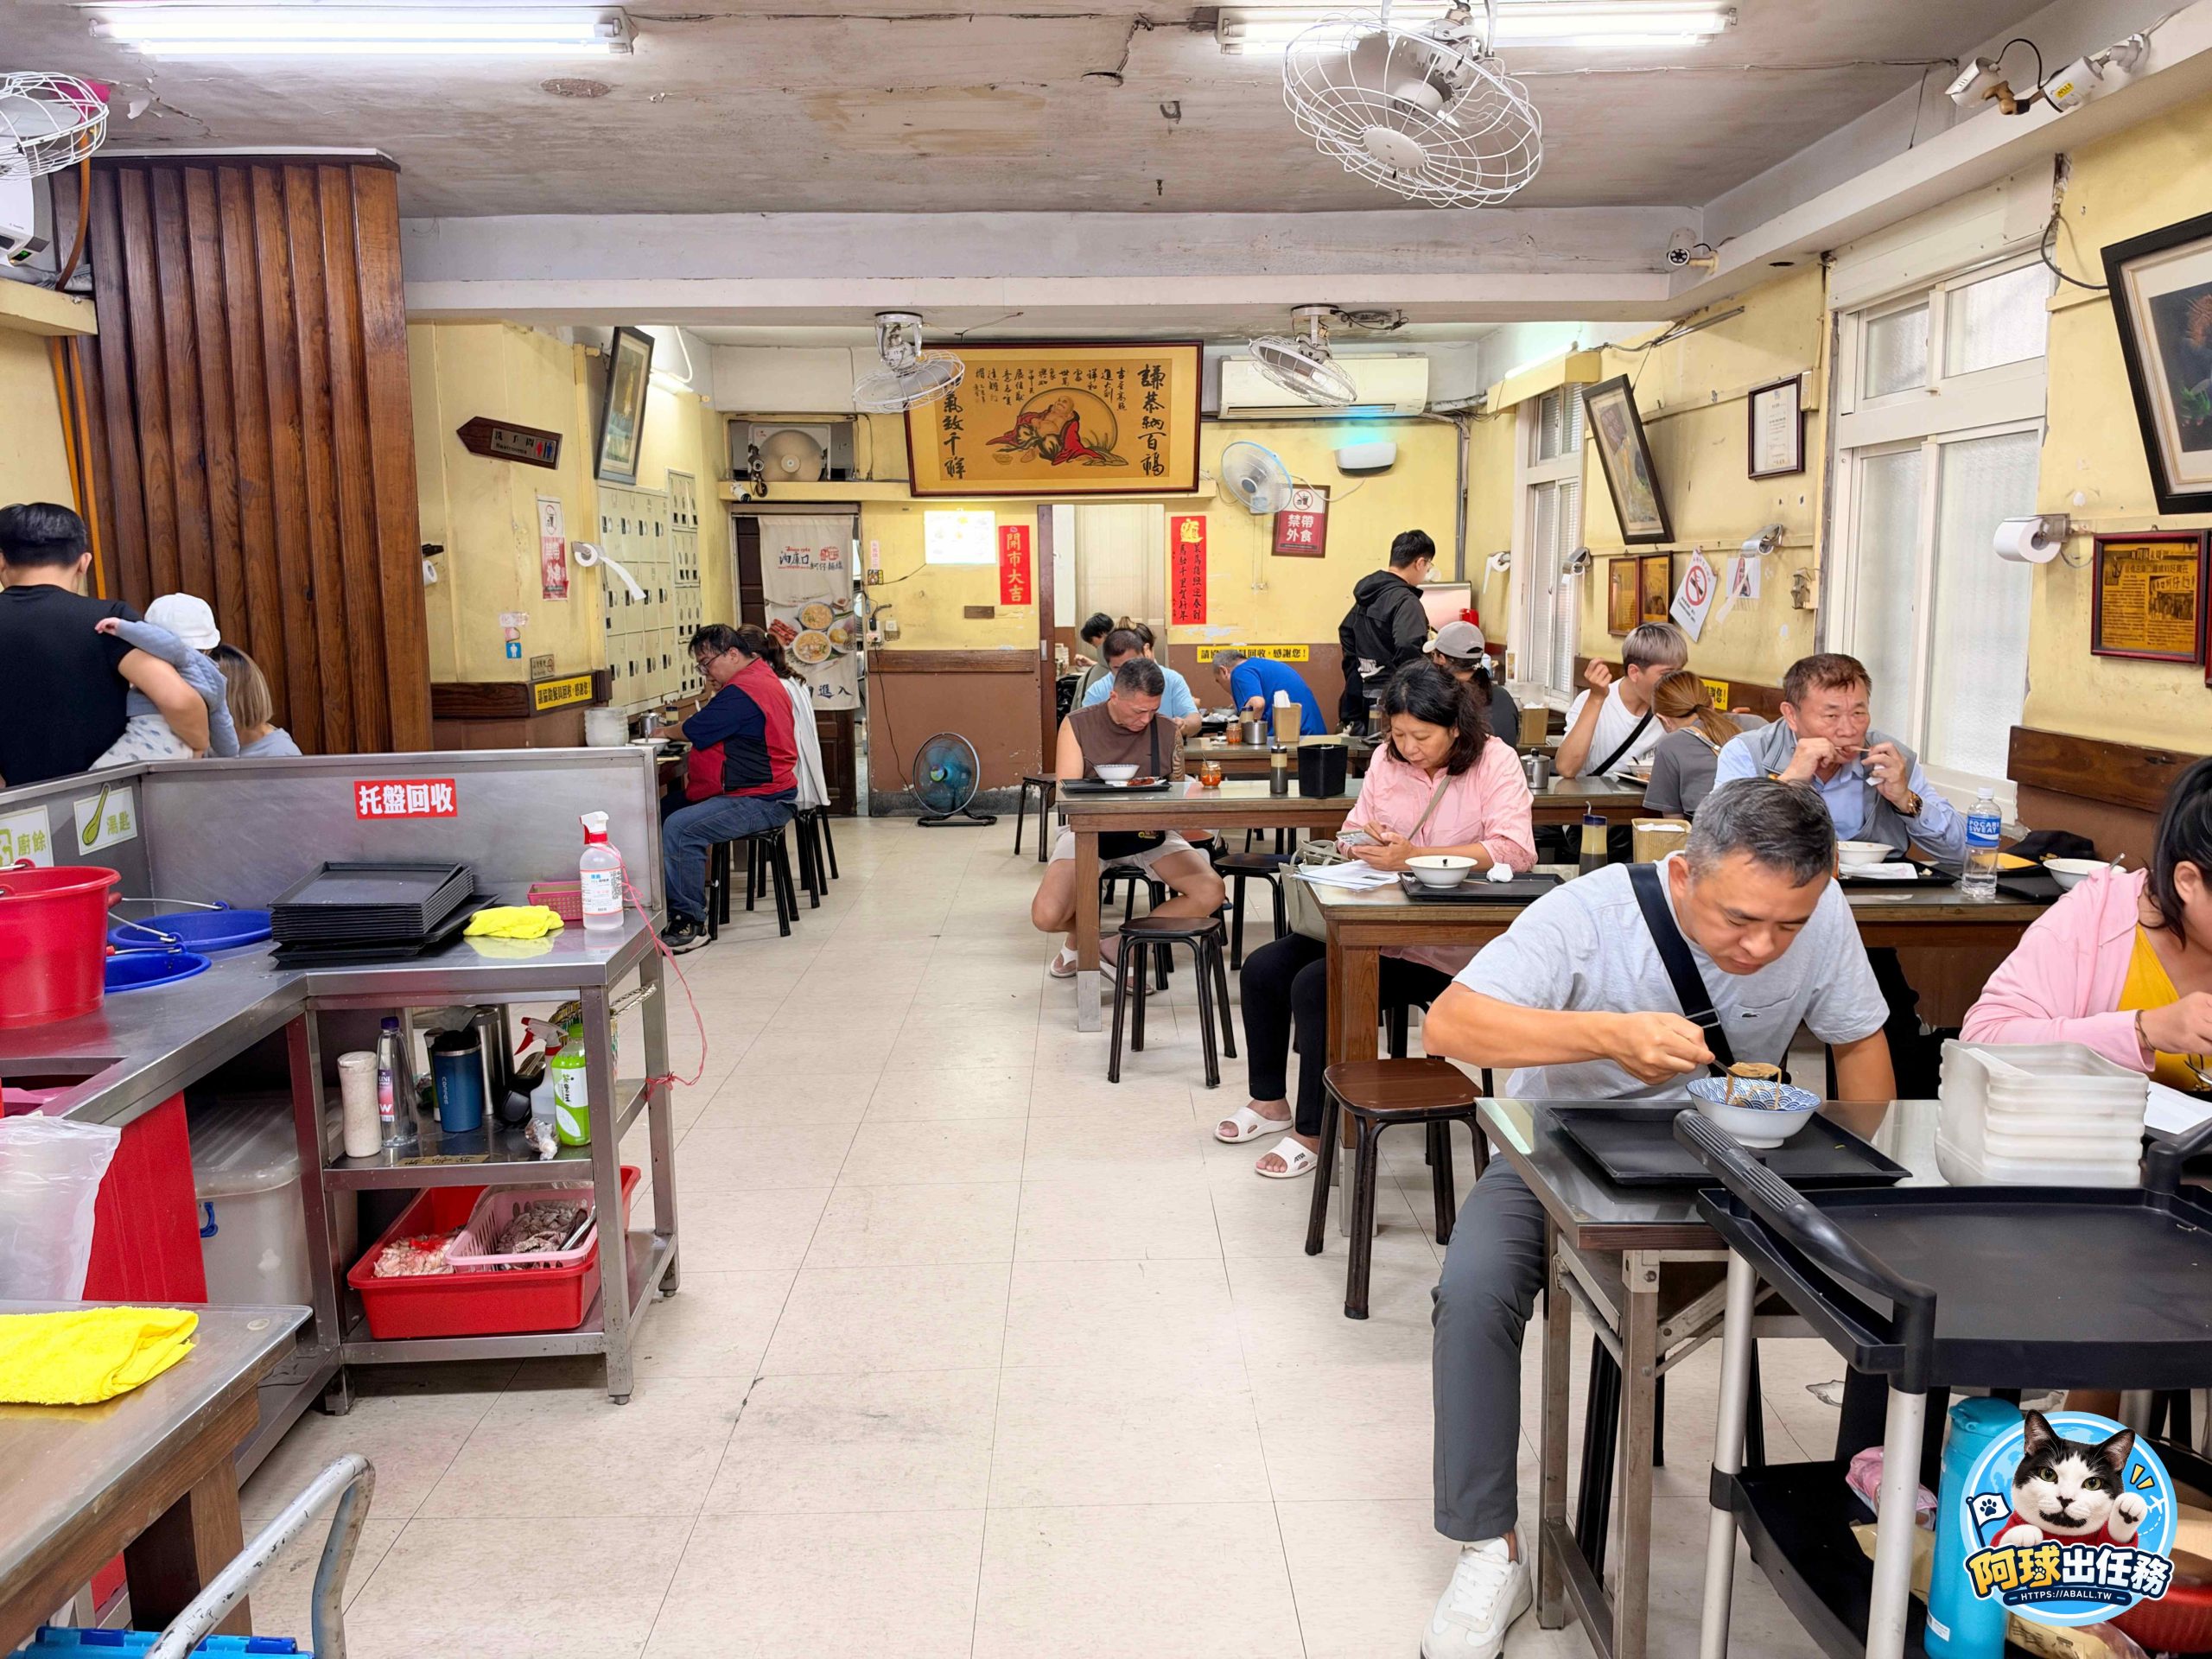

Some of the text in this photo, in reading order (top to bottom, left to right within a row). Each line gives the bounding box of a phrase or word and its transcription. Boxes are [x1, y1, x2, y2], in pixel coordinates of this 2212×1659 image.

[943, 374, 966, 480] 氣致千祥
[1137, 364, 1166, 477] 謙恭納百福
[1287, 514, 1314, 528] 禁帶
[1286, 529, 1313, 543] 外食
[1007, 532, 1025, 601] 開市大吉
[359, 783, 454, 815] 托盤回收
[107, 810, 130, 836] 湯匙
[17, 830, 46, 856] 廚餘
